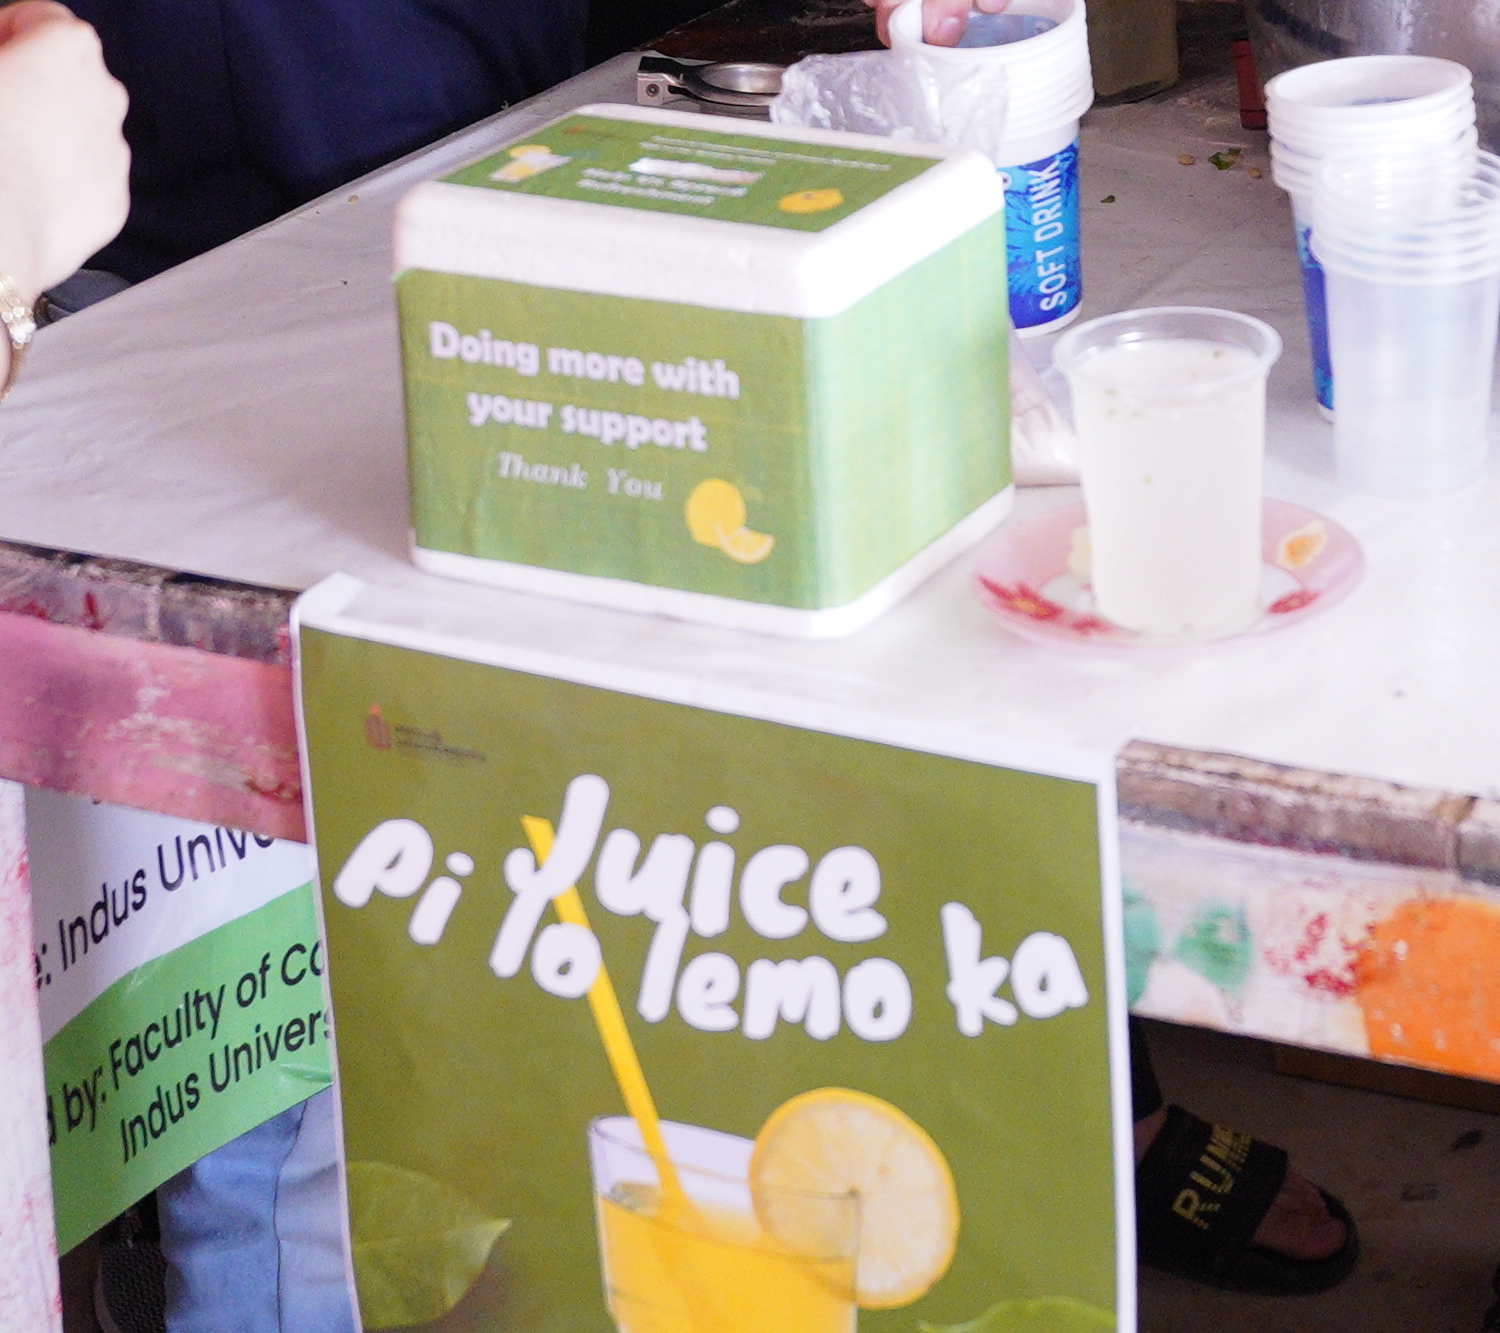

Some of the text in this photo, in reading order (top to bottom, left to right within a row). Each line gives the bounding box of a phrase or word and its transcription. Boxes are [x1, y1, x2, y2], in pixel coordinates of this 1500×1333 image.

[1027, 159, 1068, 312] SOFT DRINK
[429, 320, 741, 401] Doing more with
[466, 391, 709, 453] your support
[498, 450, 665, 502] Thank You
[504, 773, 888, 943] Juice
[58, 865, 148, 971] Indus
[332, 817, 475, 946] Pi
[940, 901, 1090, 1037] ka
[62, 1066, 107, 1133] by:
[109, 983, 227, 1090] Faculty
[235, 951, 272, 1008] of
[120, 1069, 201, 1164] Indus
